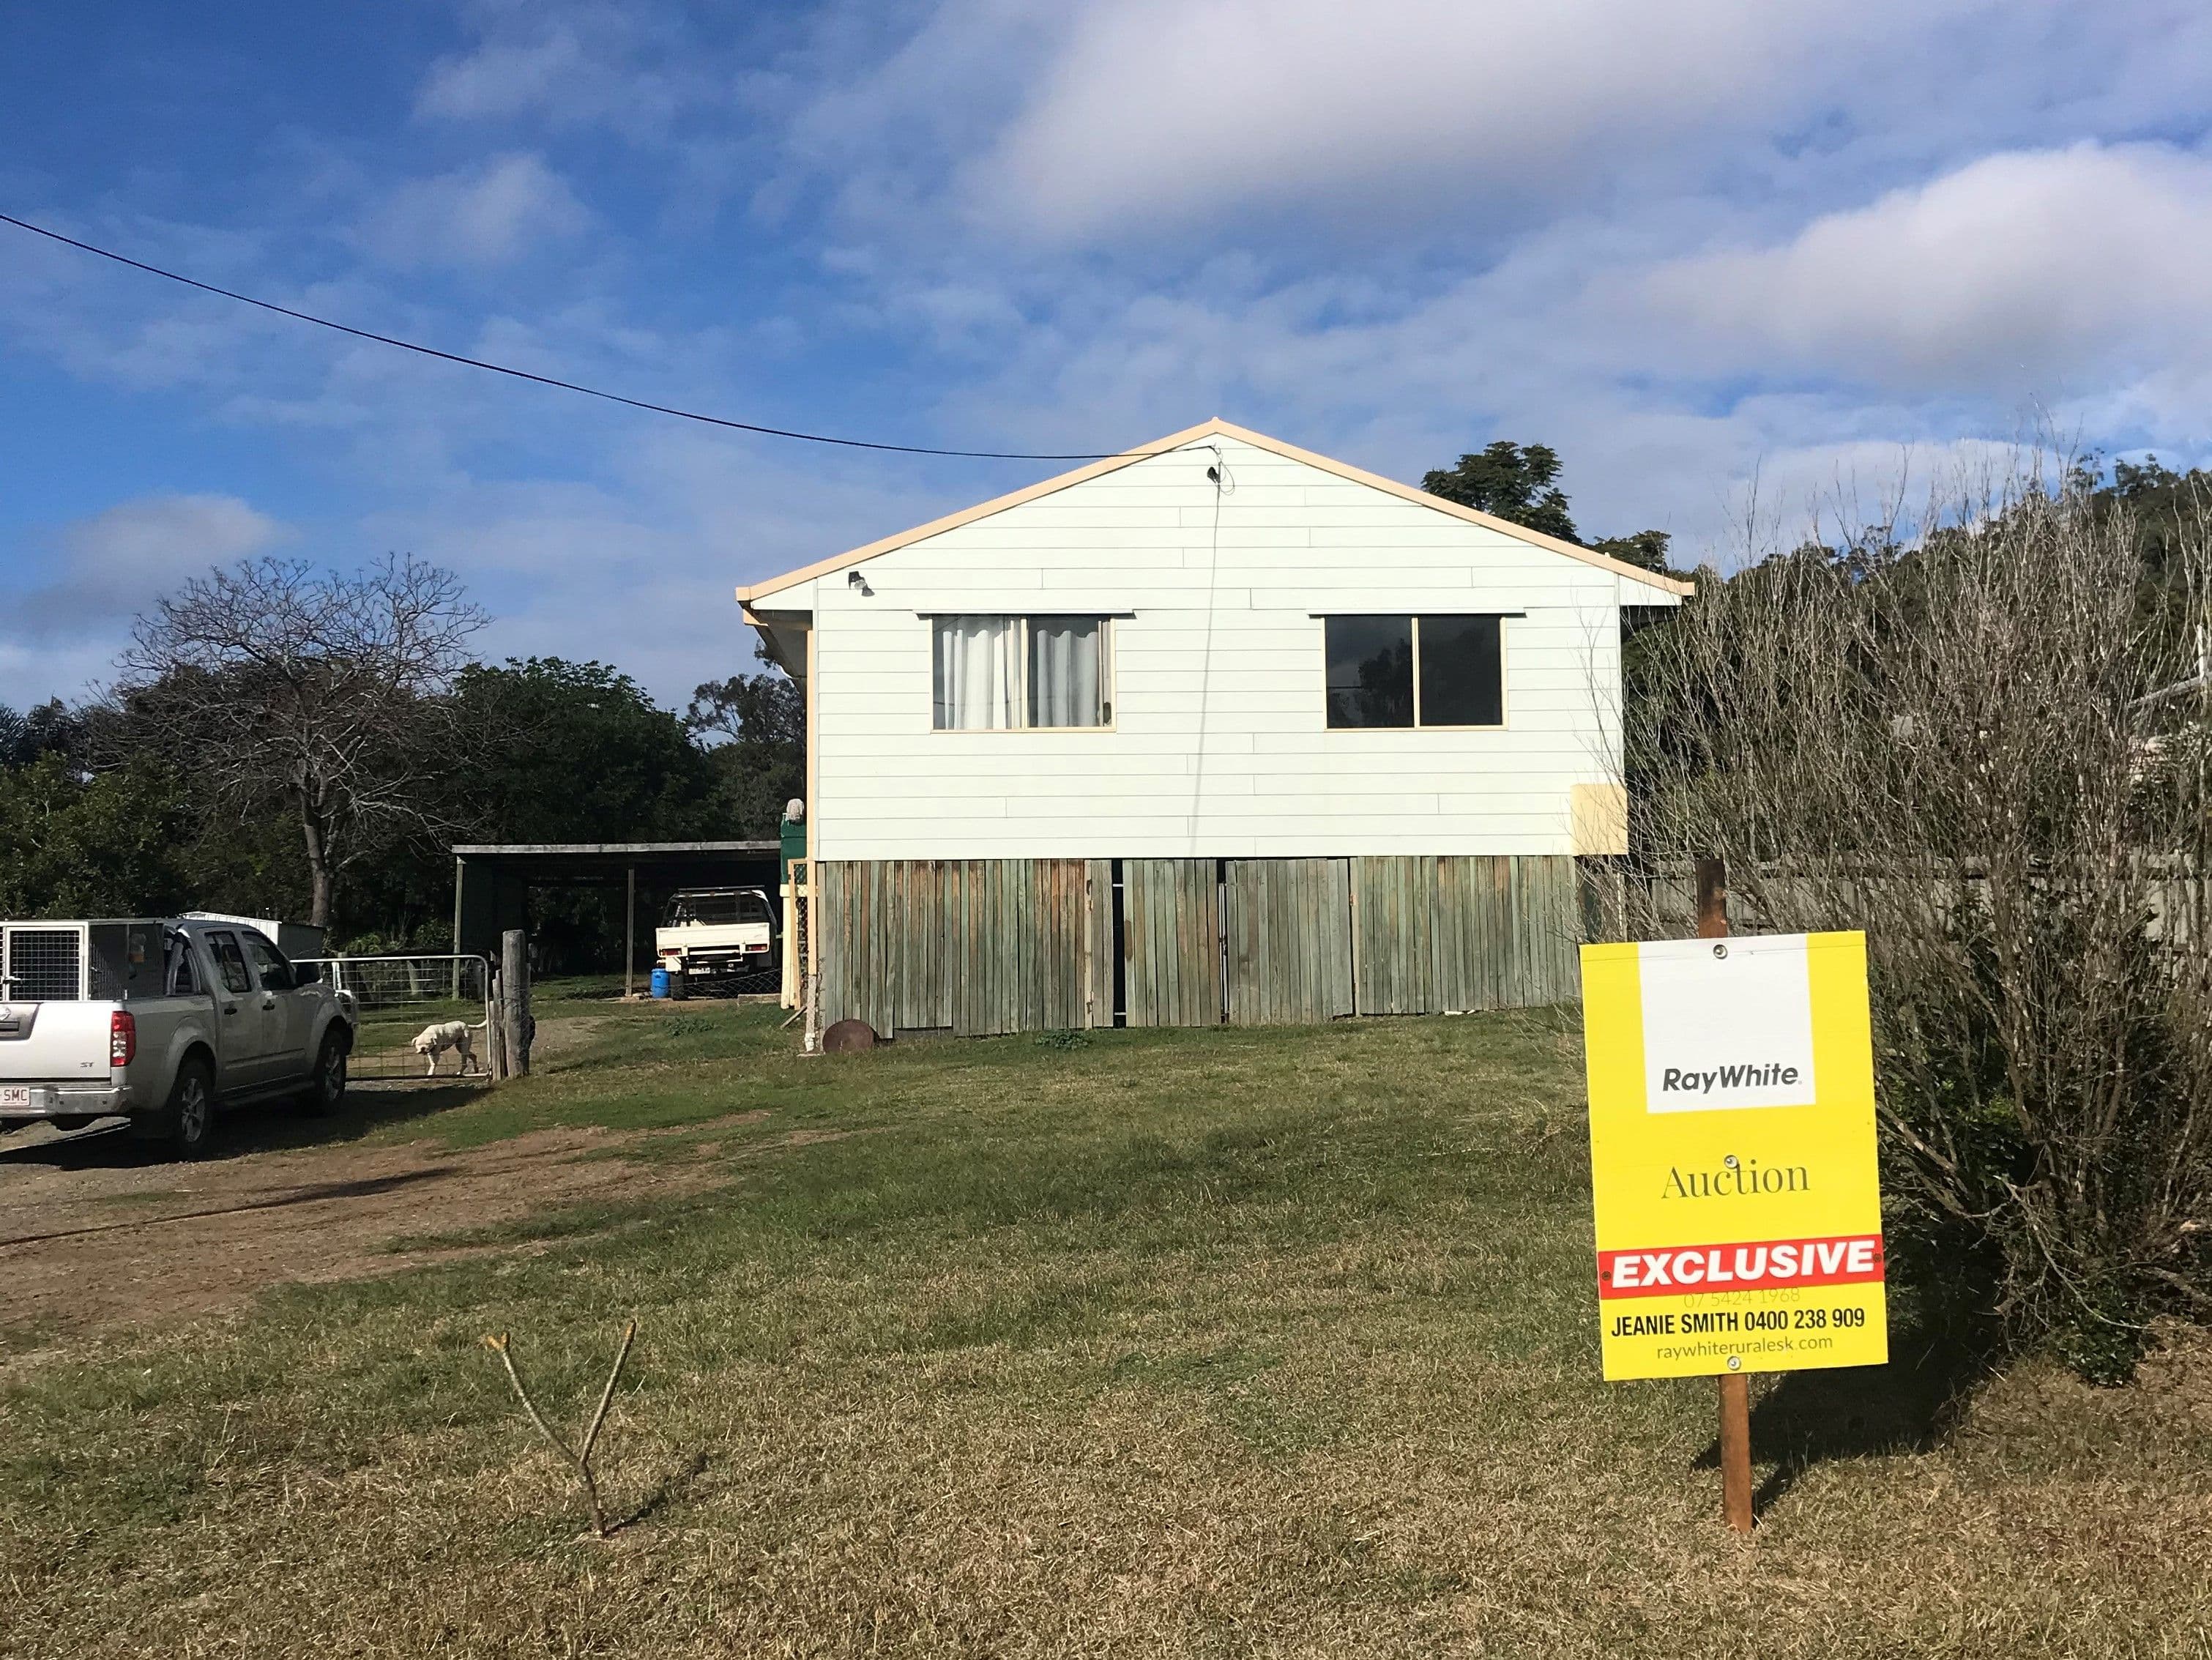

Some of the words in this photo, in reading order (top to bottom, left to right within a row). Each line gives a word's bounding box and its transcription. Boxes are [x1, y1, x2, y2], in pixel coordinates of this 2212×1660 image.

[4, 1089, 28, 1101] SMC
[1661, 1158, 1811, 1199] Auction
[1611, 1240, 1876, 1289] EXCLUSIVE
[1683, 1293, 1704, 1309] 07
[1710, 1290, 1752, 1307] 5424
[1759, 1287, 1800, 1304] 1968
[1611, 1315, 1675, 1337] JEANIE
[1681, 1311, 1739, 1334] SMITH
[1745, 1310, 1788, 1331] 0400
[1794, 1309, 1827, 1330] 238
[1832, 1307, 1865, 1328] 909
[1657, 1336, 1833, 1361] raywhiteruralesk.com
